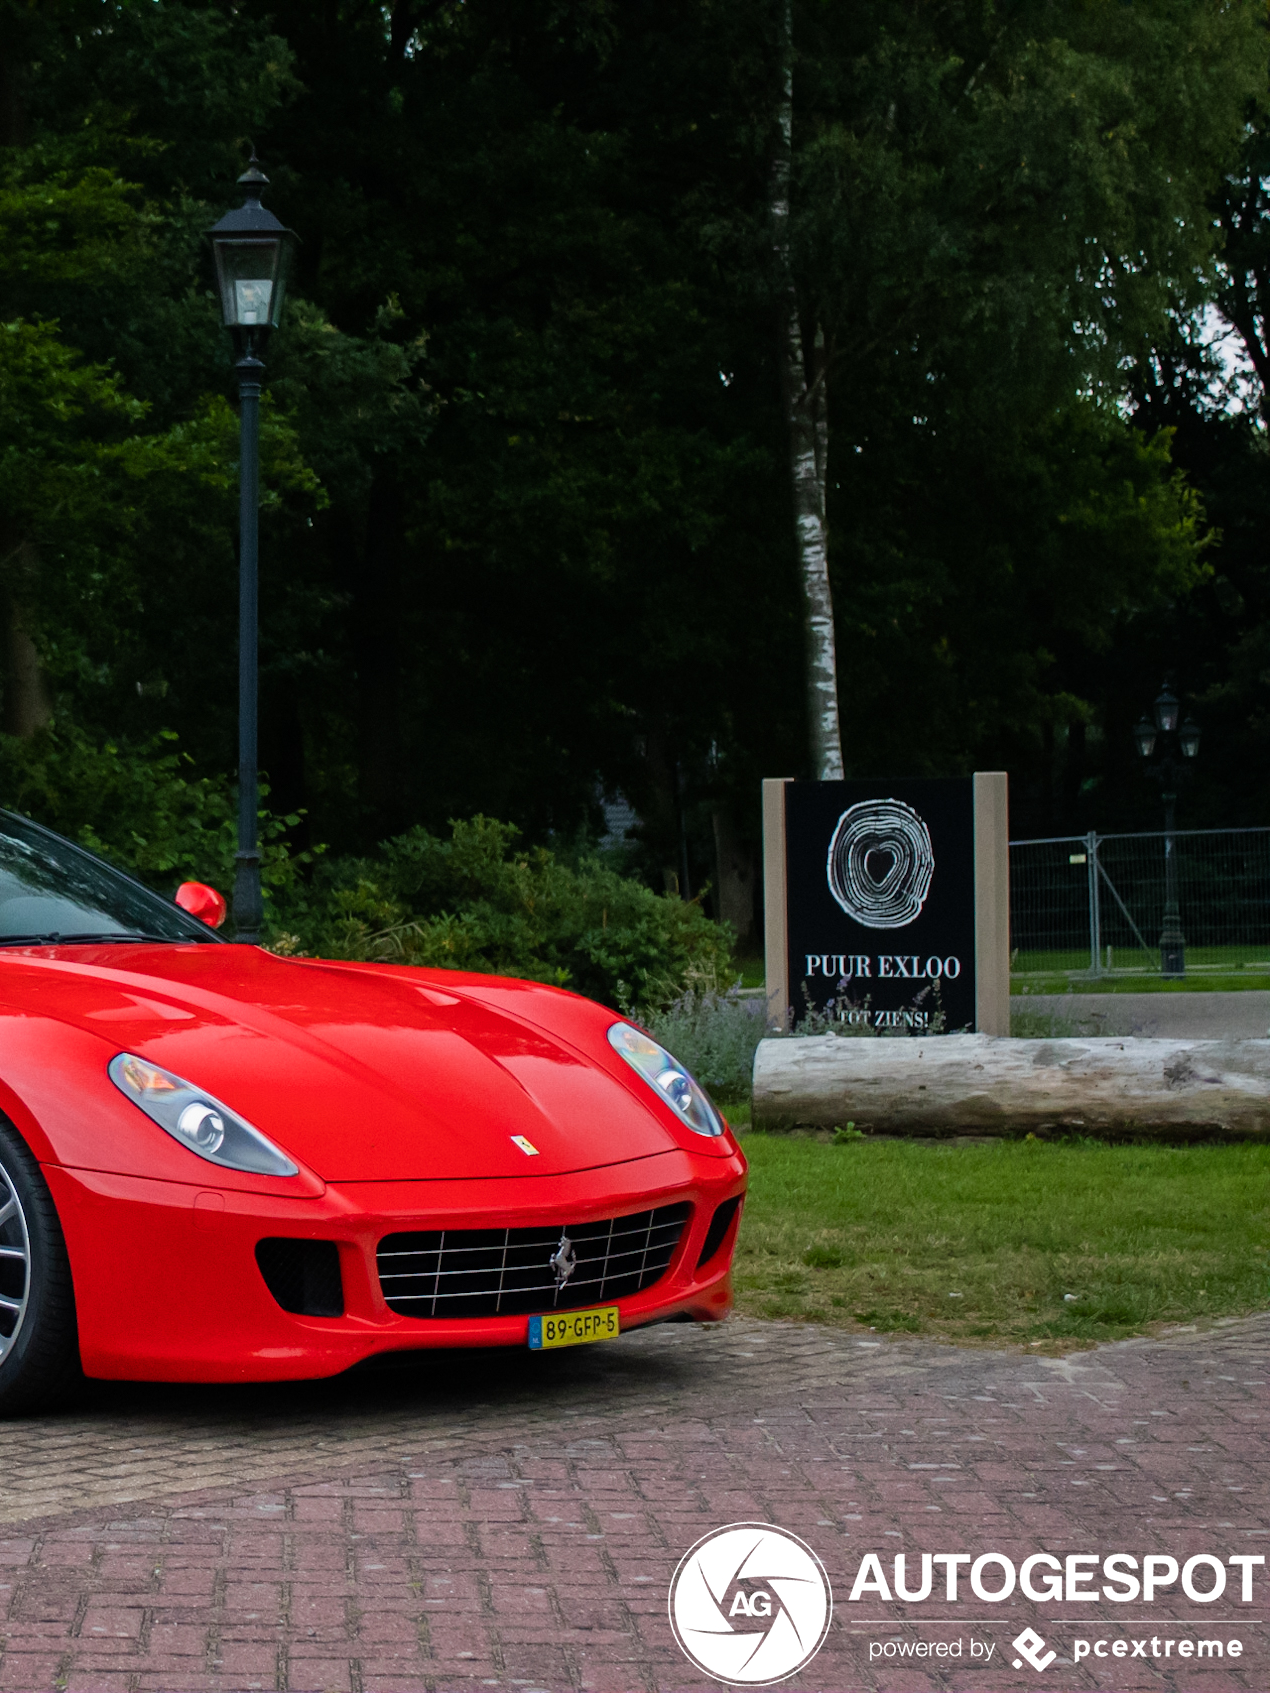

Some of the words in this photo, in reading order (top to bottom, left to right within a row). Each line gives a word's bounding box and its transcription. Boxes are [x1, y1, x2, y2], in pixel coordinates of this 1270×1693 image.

[805, 954, 872, 977] PUUR
[878, 955, 961, 979] EXLOO
[875, 1010, 929, 1028] ZIENS!
[546, 1312, 615, 1341] 89-GFP-5
